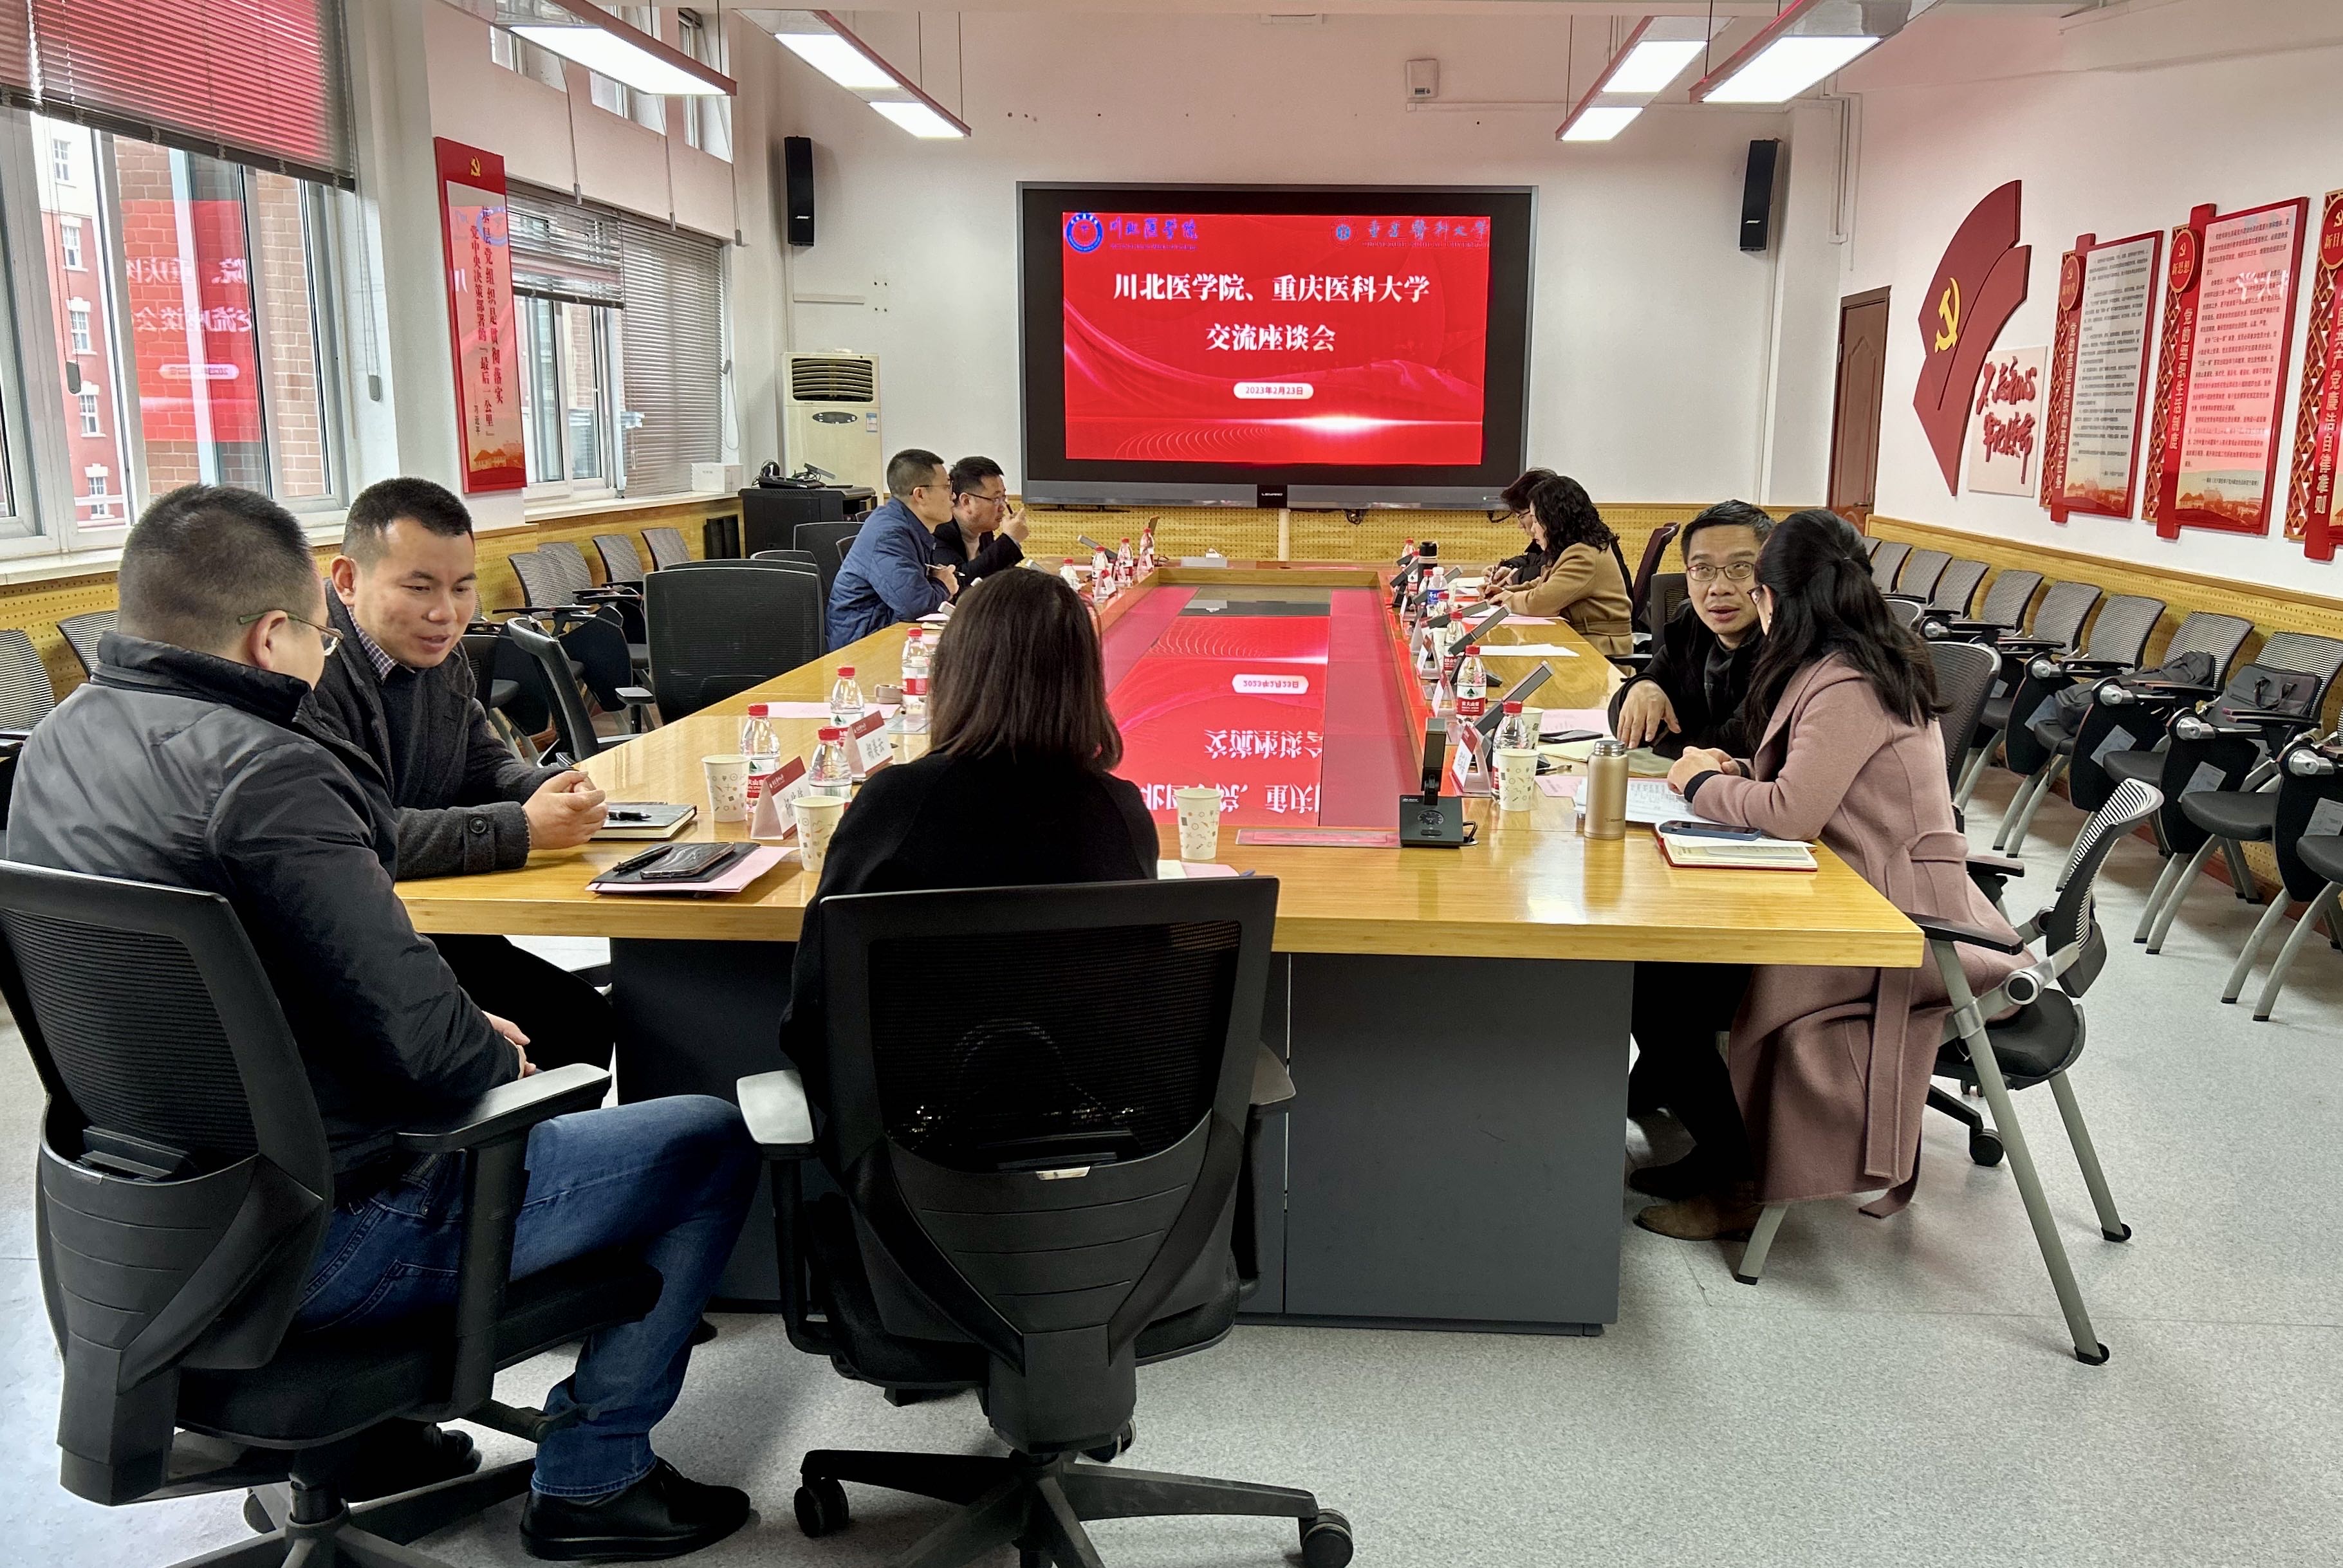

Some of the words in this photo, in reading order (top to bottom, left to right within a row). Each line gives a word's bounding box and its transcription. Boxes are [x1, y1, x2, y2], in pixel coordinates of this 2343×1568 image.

[2171, 259, 2191, 275] 新思想
[1113, 273, 1431, 304] 川北医学院、重庆医科大学
[1205, 323, 1337, 352] 交流座谈会
[1245, 386, 1303, 395] 2023年2月23日
[1976, 356, 2037, 415] 不忘初心
[1983, 412, 2036, 484] 牢记使命
